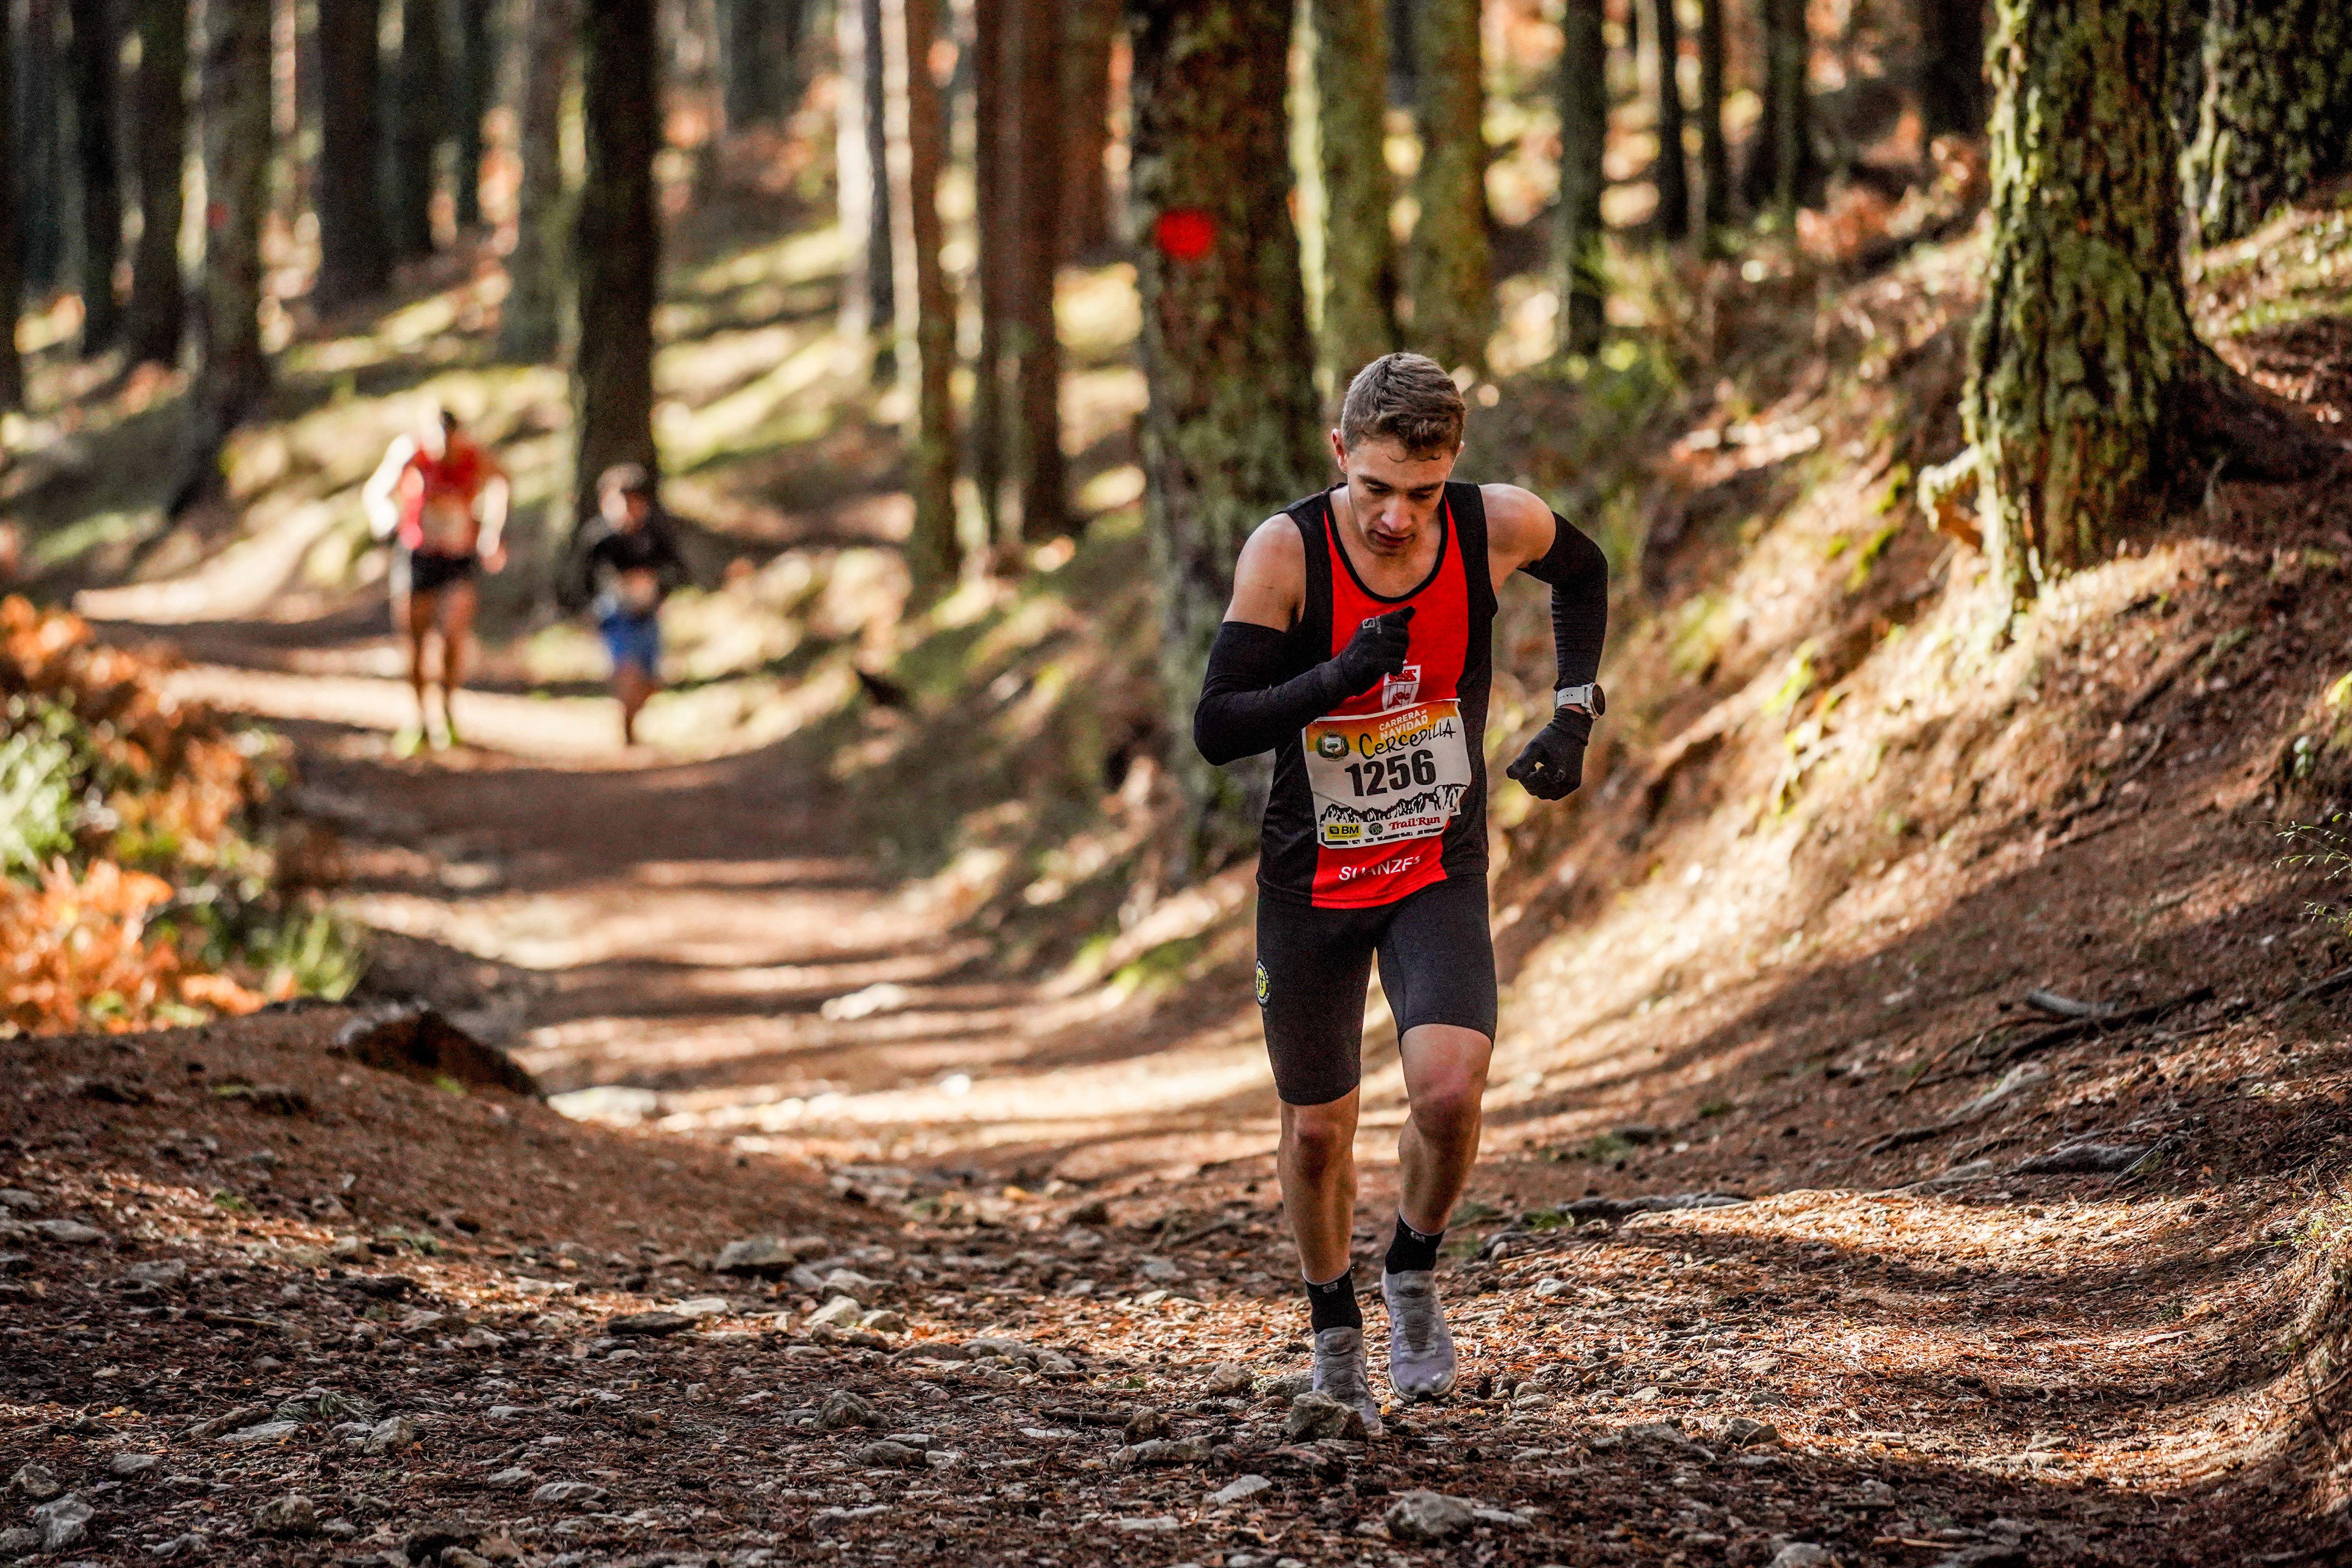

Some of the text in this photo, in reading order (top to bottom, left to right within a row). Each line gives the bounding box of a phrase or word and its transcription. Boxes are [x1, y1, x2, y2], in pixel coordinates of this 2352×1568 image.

[1379, 710, 1421, 730] CARRERA
[1380, 715, 1428, 740] NAVIDAD
[1345, 750, 1436, 796] 1256
[1342, 826, 1359, 834] BM
[1389, 817, 1441, 830] Trail Run
